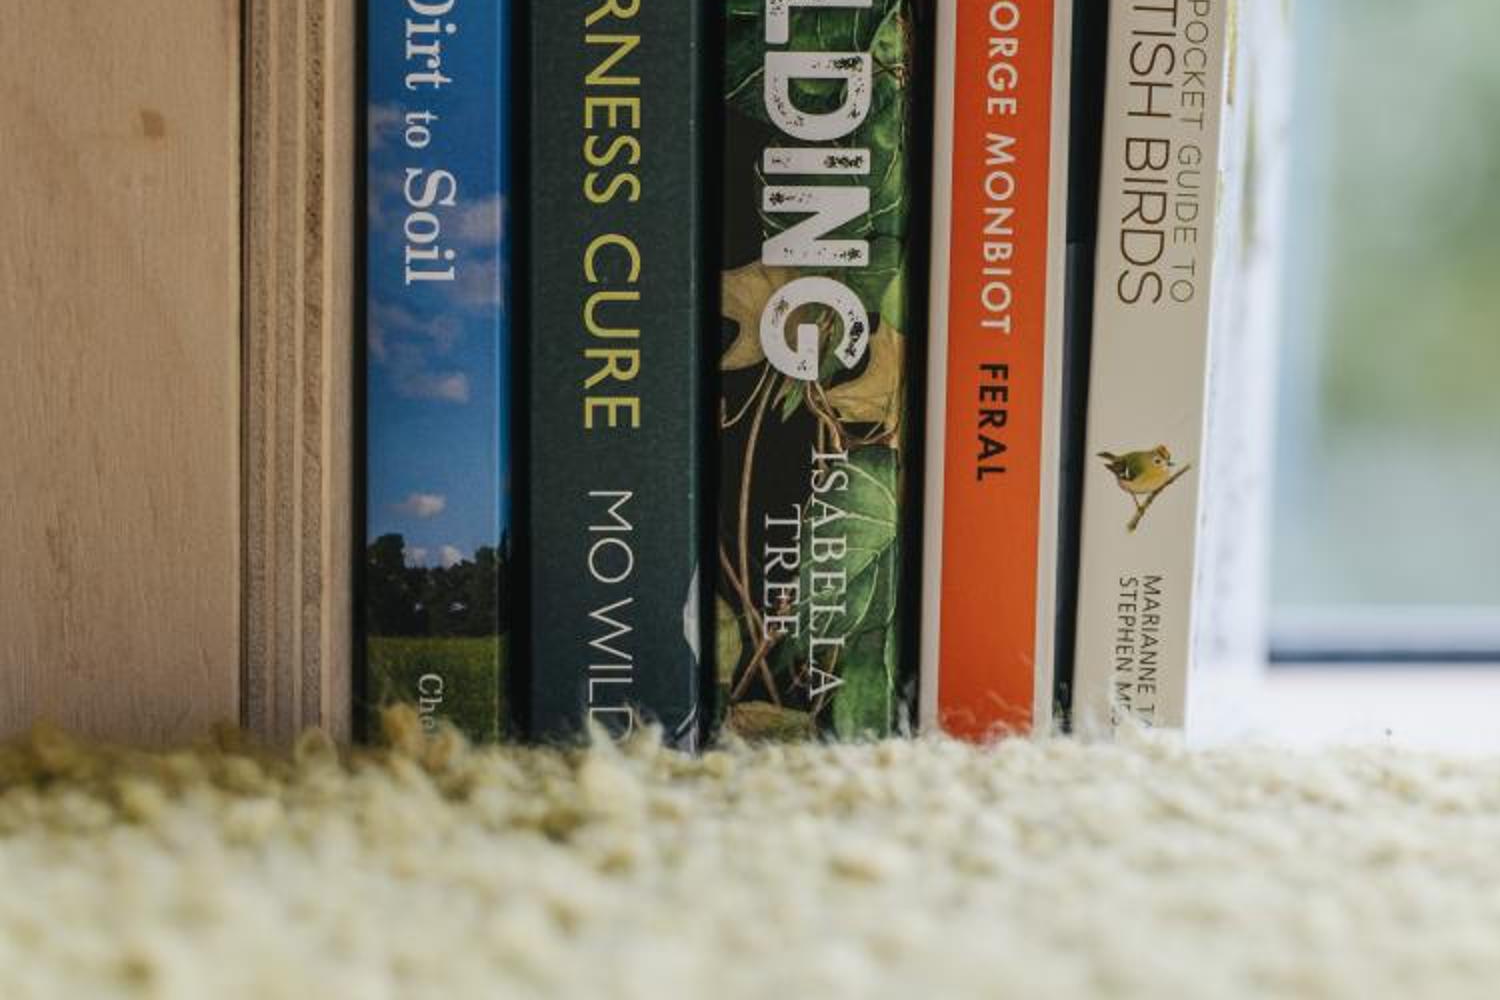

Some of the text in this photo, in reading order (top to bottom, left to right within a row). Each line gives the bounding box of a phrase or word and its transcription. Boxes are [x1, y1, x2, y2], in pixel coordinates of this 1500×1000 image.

[404, 109, 438, 149] to
[403, 166, 457, 286] Soil
[980, 131, 1018, 335] MONBIOT
[1116, 136, 1171, 305] BIRDS
[1172, 144, 1202, 244] GUIDE
[583, 232, 642, 430] CURE
[1169, 259, 1196, 304] TO
[975, 362, 1009, 482] FERAL
[587, 490, 634, 584] MO
[762, 503, 801, 641] TREE
[808, 445, 849, 701] ISABELLA
[1114, 576, 1139, 673] STEPHEN
[1137, 574, 1163, 695] MARIANNE
